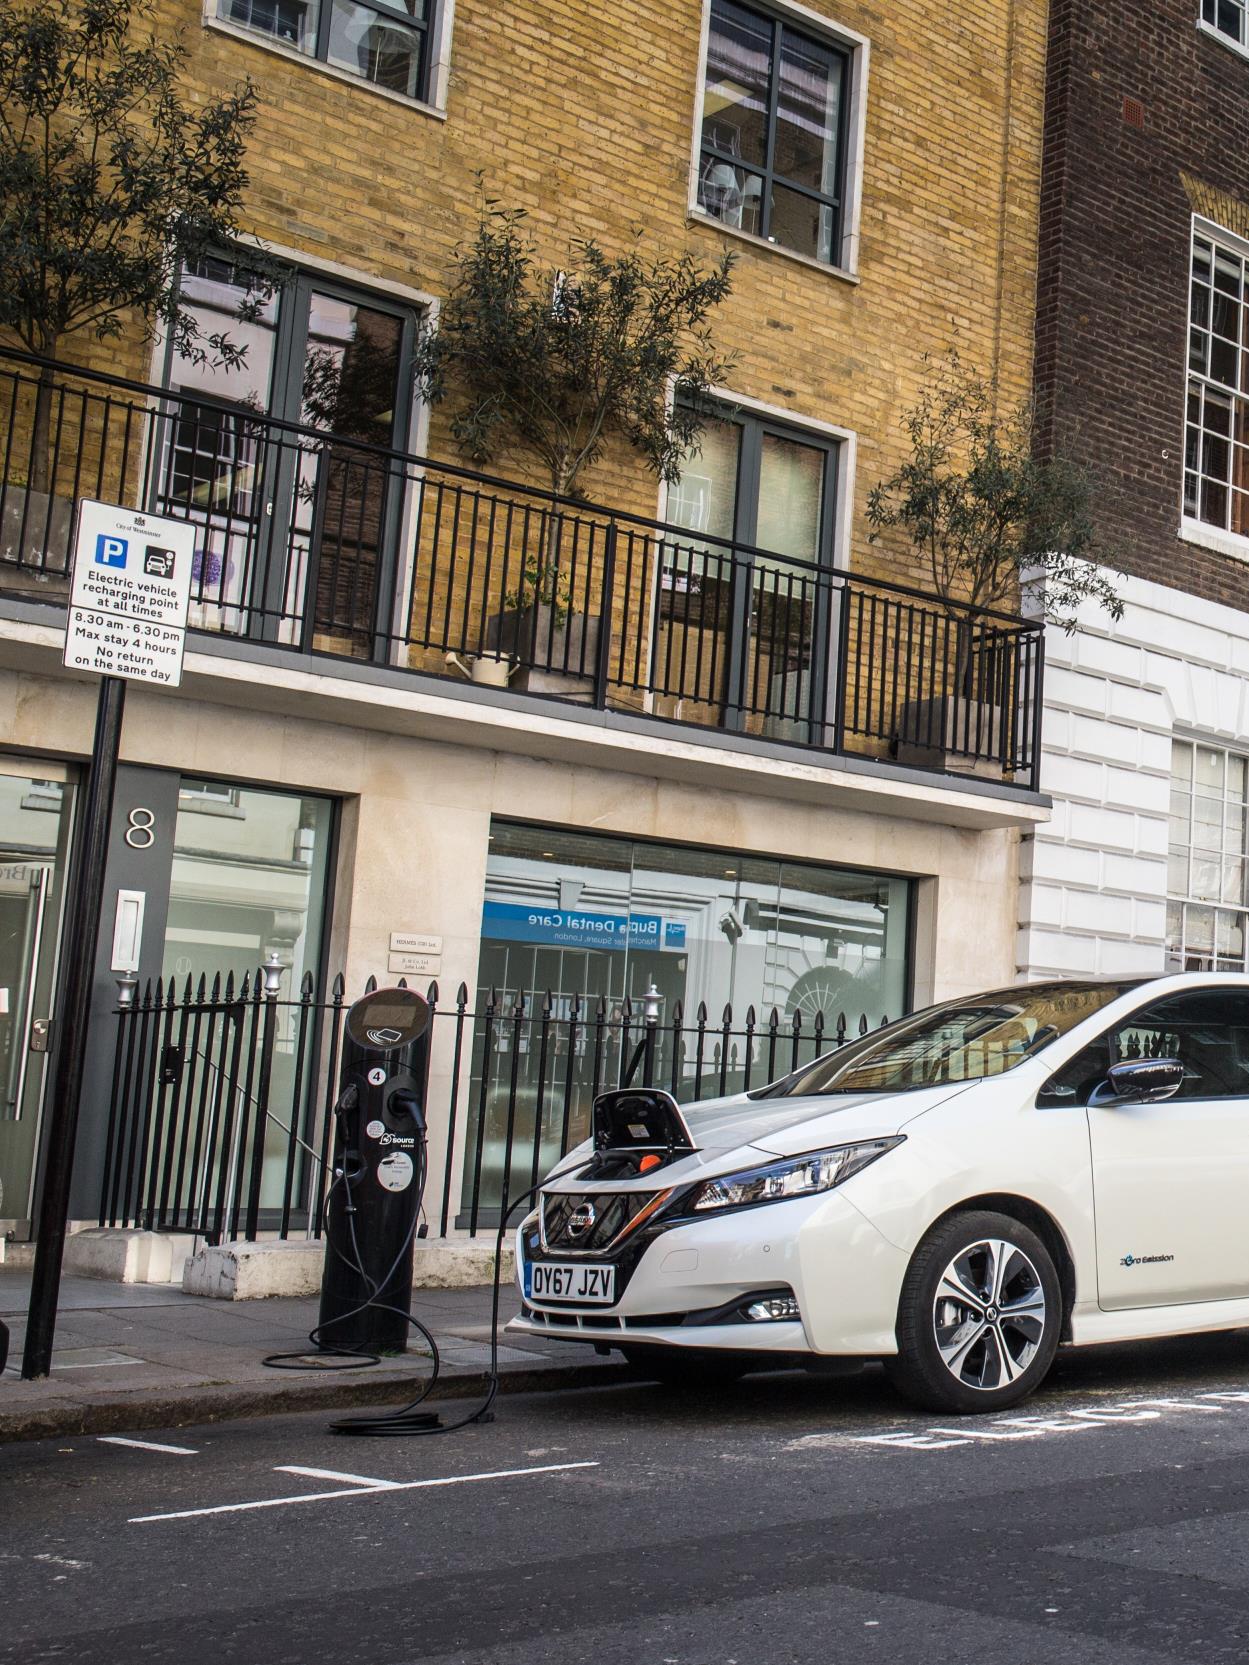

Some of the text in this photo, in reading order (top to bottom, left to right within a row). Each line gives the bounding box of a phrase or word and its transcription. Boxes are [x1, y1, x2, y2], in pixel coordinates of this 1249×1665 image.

[102, 540, 124, 563] P
[82, 582, 179, 610] recharging point
[88, 571, 177, 598] Electric vehicle
[97, 597, 163, 618] at all times
[75, 612, 104, 626] 8.30
[106, 620, 124, 630] am
[133, 624, 160, 638] 6.30
[163, 631, 180, 642] pm
[75, 627, 177, 655] Max stay 4 hours
[75, 656, 171, 682] on the same day
[96, 646, 154, 666] No return
[126, 808, 154, 848] 8
[373, 1072, 380, 1081] 4
[534, 1267, 610, 1296] OY67 JZV
